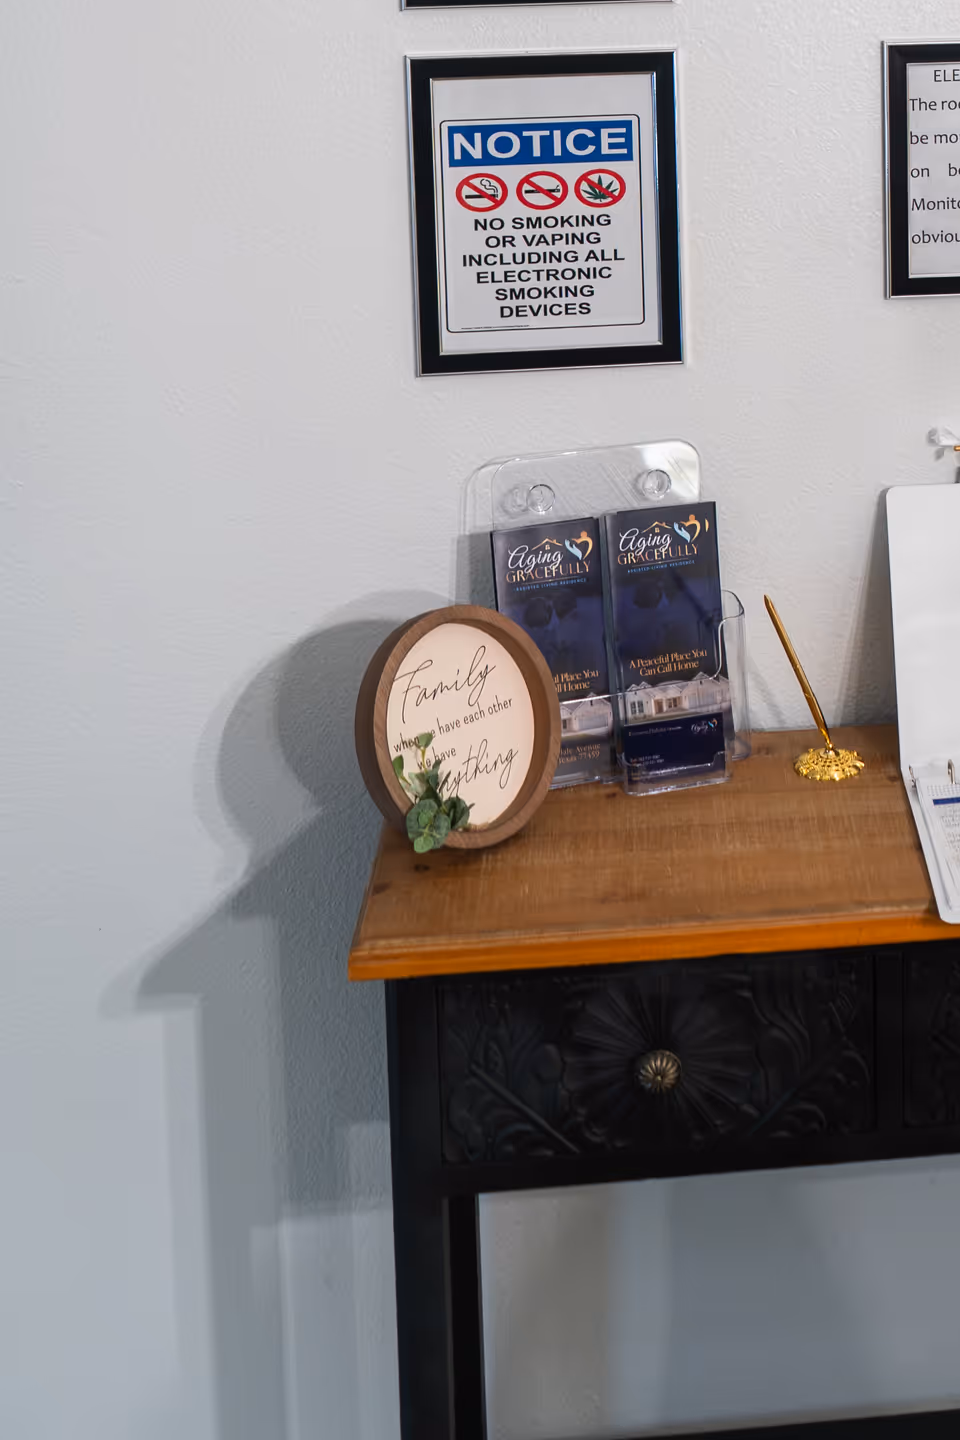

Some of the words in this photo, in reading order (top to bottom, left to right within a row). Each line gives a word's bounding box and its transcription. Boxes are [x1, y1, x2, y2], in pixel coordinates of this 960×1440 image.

[909, 97, 937, 112] The
[452, 127, 628, 160] NOTICE
[909, 130, 929, 145] be
[910, 167, 930, 179] on
[473, 217, 505, 231] NO
[511, 213, 611, 230] SMOKING
[484, 235, 516, 249] OR
[521, 231, 601, 247] VAPING
[462, 250, 579, 267] INCLUDING
[584, 248, 625, 262] ALL
[476, 266, 612, 284] ELECTRONIC
[494, 284, 595, 301] SMOKING
[499, 302, 591, 318] DEVICES
[618, 528, 673, 555] Aging
[507, 545, 564, 573] Aging
[617, 543, 697, 565] GRACEFULLY
[505, 561, 589, 582] GRACEFULLY
[629, 660, 636, 669] A
[637, 653, 672, 668] Peaceful
[670, 652, 691, 664] Place
[691, 649, 707, 658] You
[638, 664, 656, 677] Can
[656, 662, 673, 674] Call
[673, 660, 699, 671] Home
[393, 645, 496, 724] Family
[436, 717, 461, 735] have
[463, 702, 485, 725] each
[488, 695, 513, 715] other
